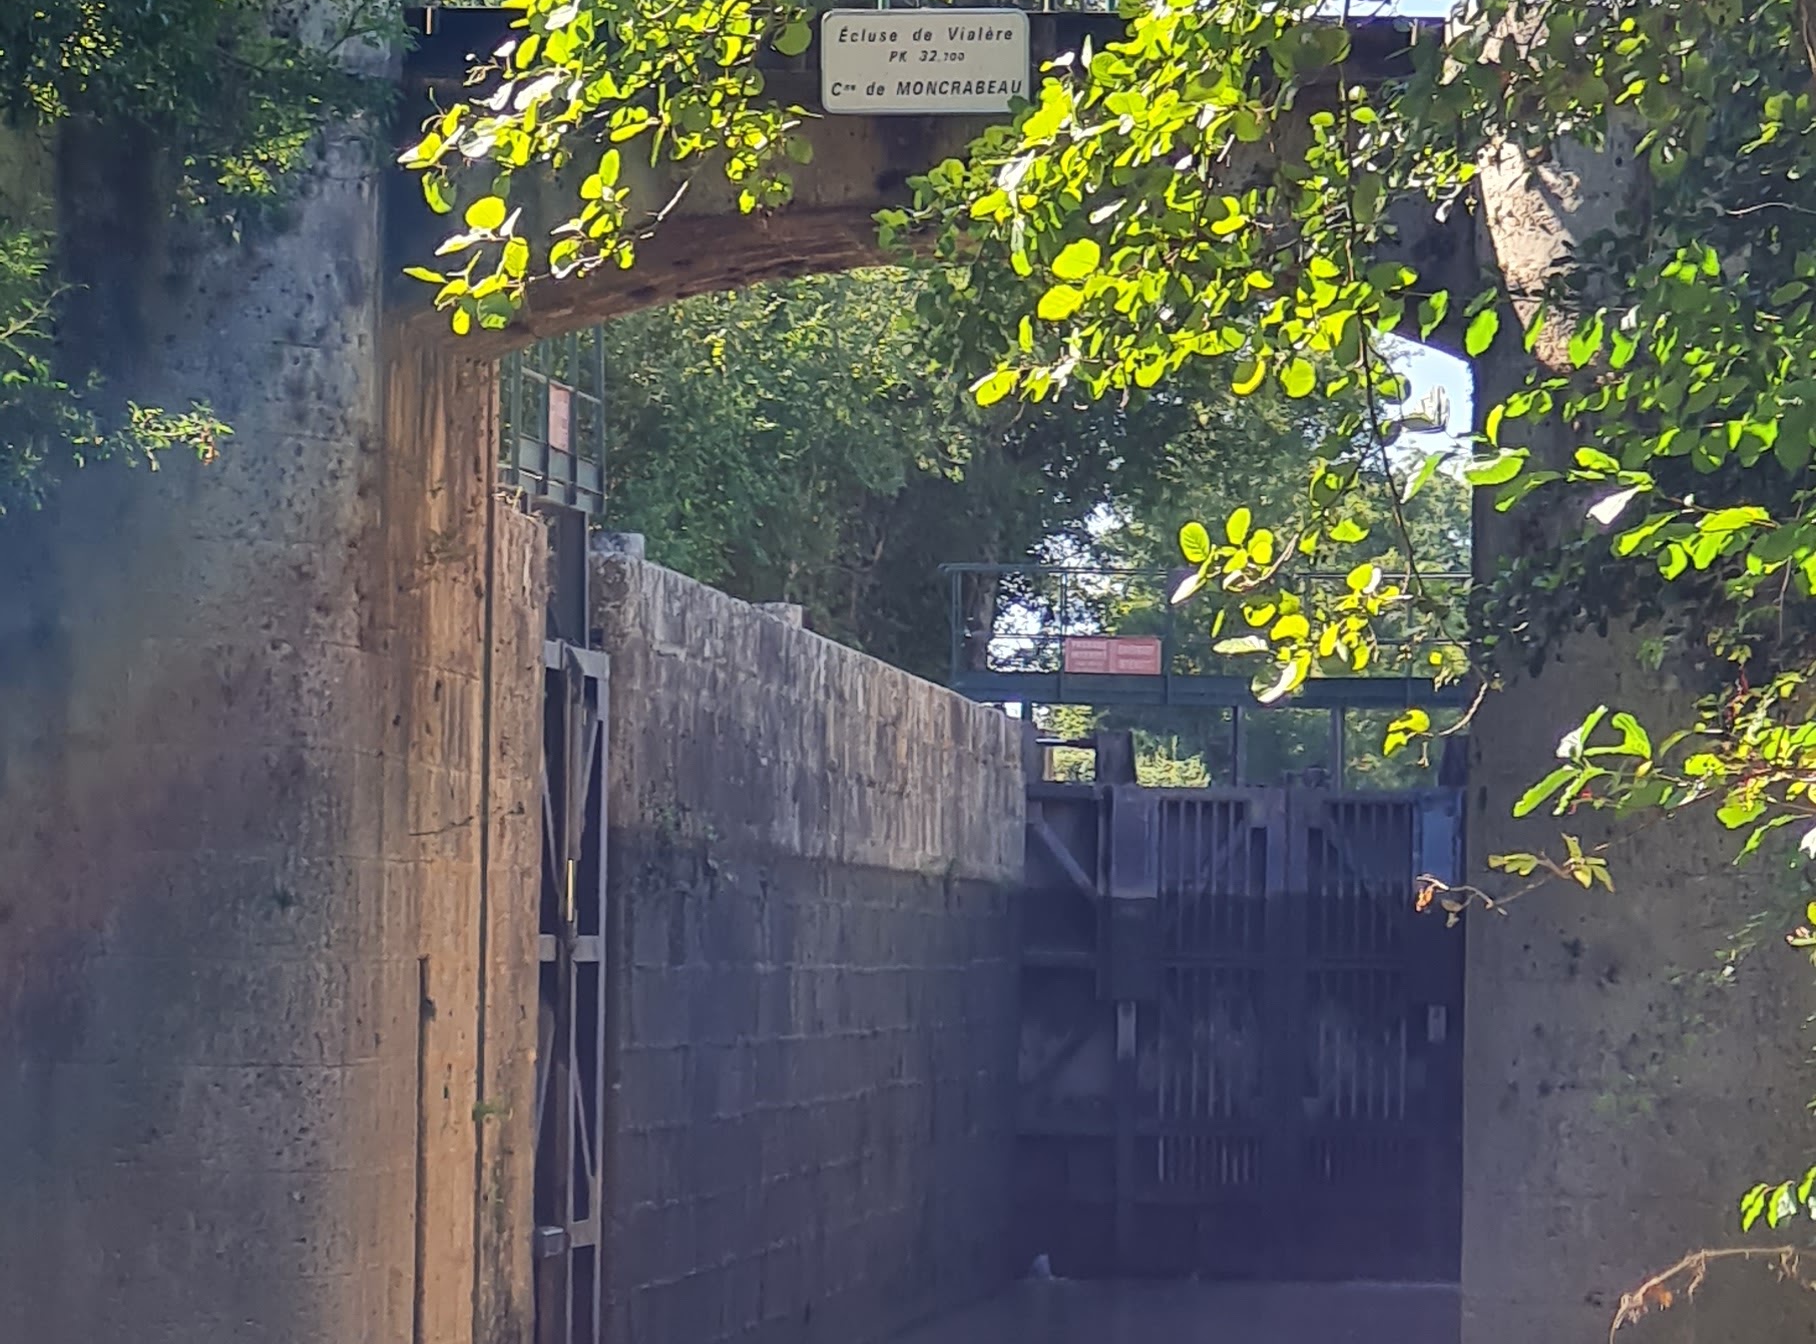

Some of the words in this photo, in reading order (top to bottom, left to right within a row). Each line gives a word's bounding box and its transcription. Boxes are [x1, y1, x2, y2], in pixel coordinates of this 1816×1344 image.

[838, 25, 898, 43] Écluse
[912, 27, 933, 42] de
[947, 26, 1013, 42] Vialère
[888, 50, 908, 63] PK
[866, 81, 885, 96] de
[896, 79, 1022, 96] MONCRABEAU
